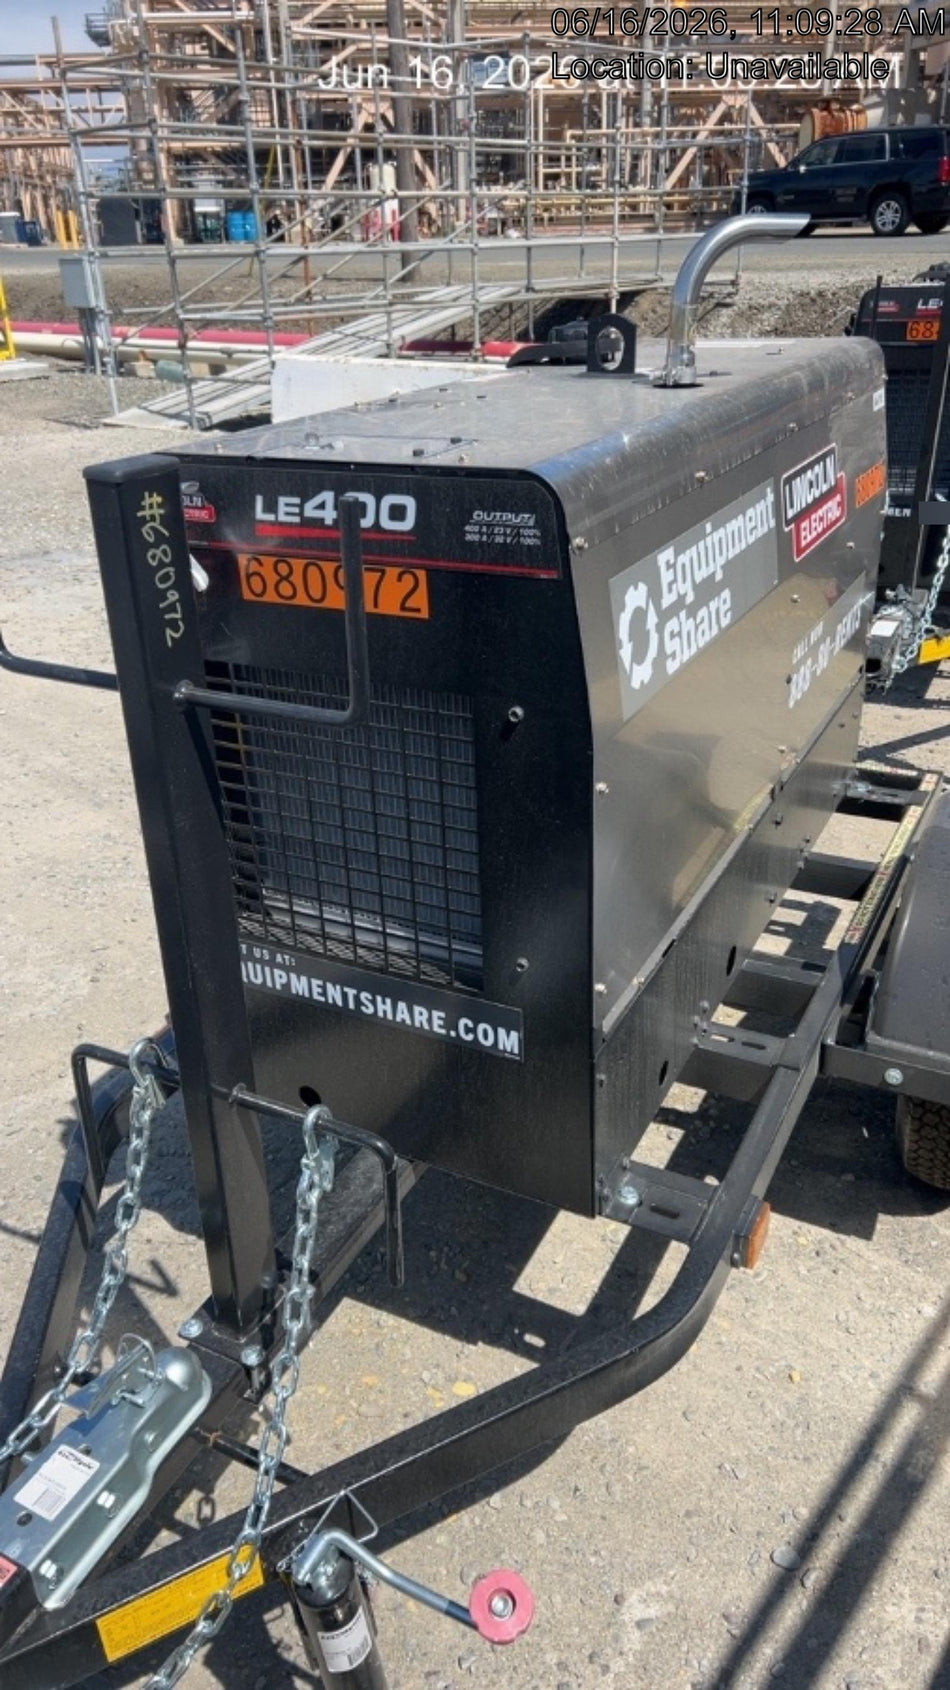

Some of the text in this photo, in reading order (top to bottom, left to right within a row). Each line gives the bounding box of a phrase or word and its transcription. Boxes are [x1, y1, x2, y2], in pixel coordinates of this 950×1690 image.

[909, 321, 940, 339] 68
[254, 490, 417, 532] LE400
[785, 453, 836, 520] LINCOLN
[657, 487, 776, 610] Equipment
[800, 493, 842, 548] ELECTRIC
[137, 491, 185, 648] #680972
[664, 588, 731, 675] Share
